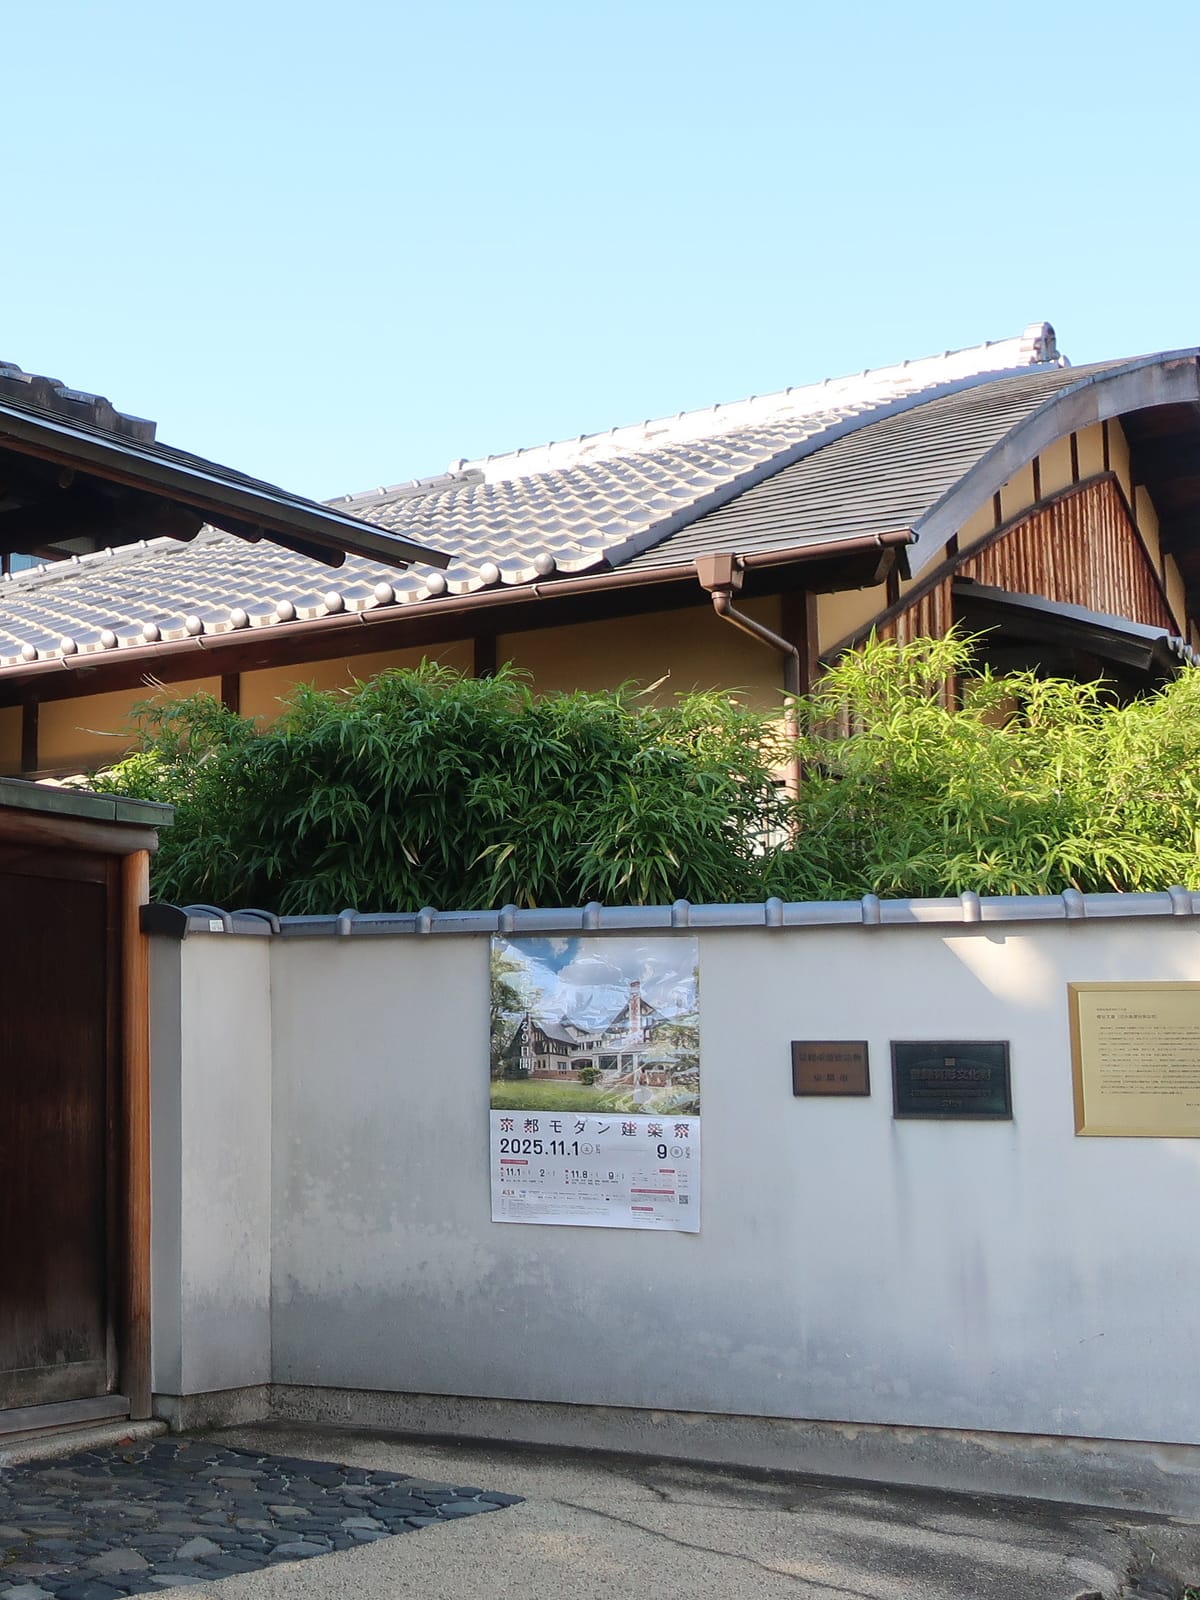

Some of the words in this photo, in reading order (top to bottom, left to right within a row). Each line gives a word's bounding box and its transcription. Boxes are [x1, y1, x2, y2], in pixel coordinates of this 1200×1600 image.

[500, 1117, 690, 1138] 京都モダン建築祭
[500, 1138, 579, 1156] 2025.11.1
[657, 1144, 667, 1159] 9
